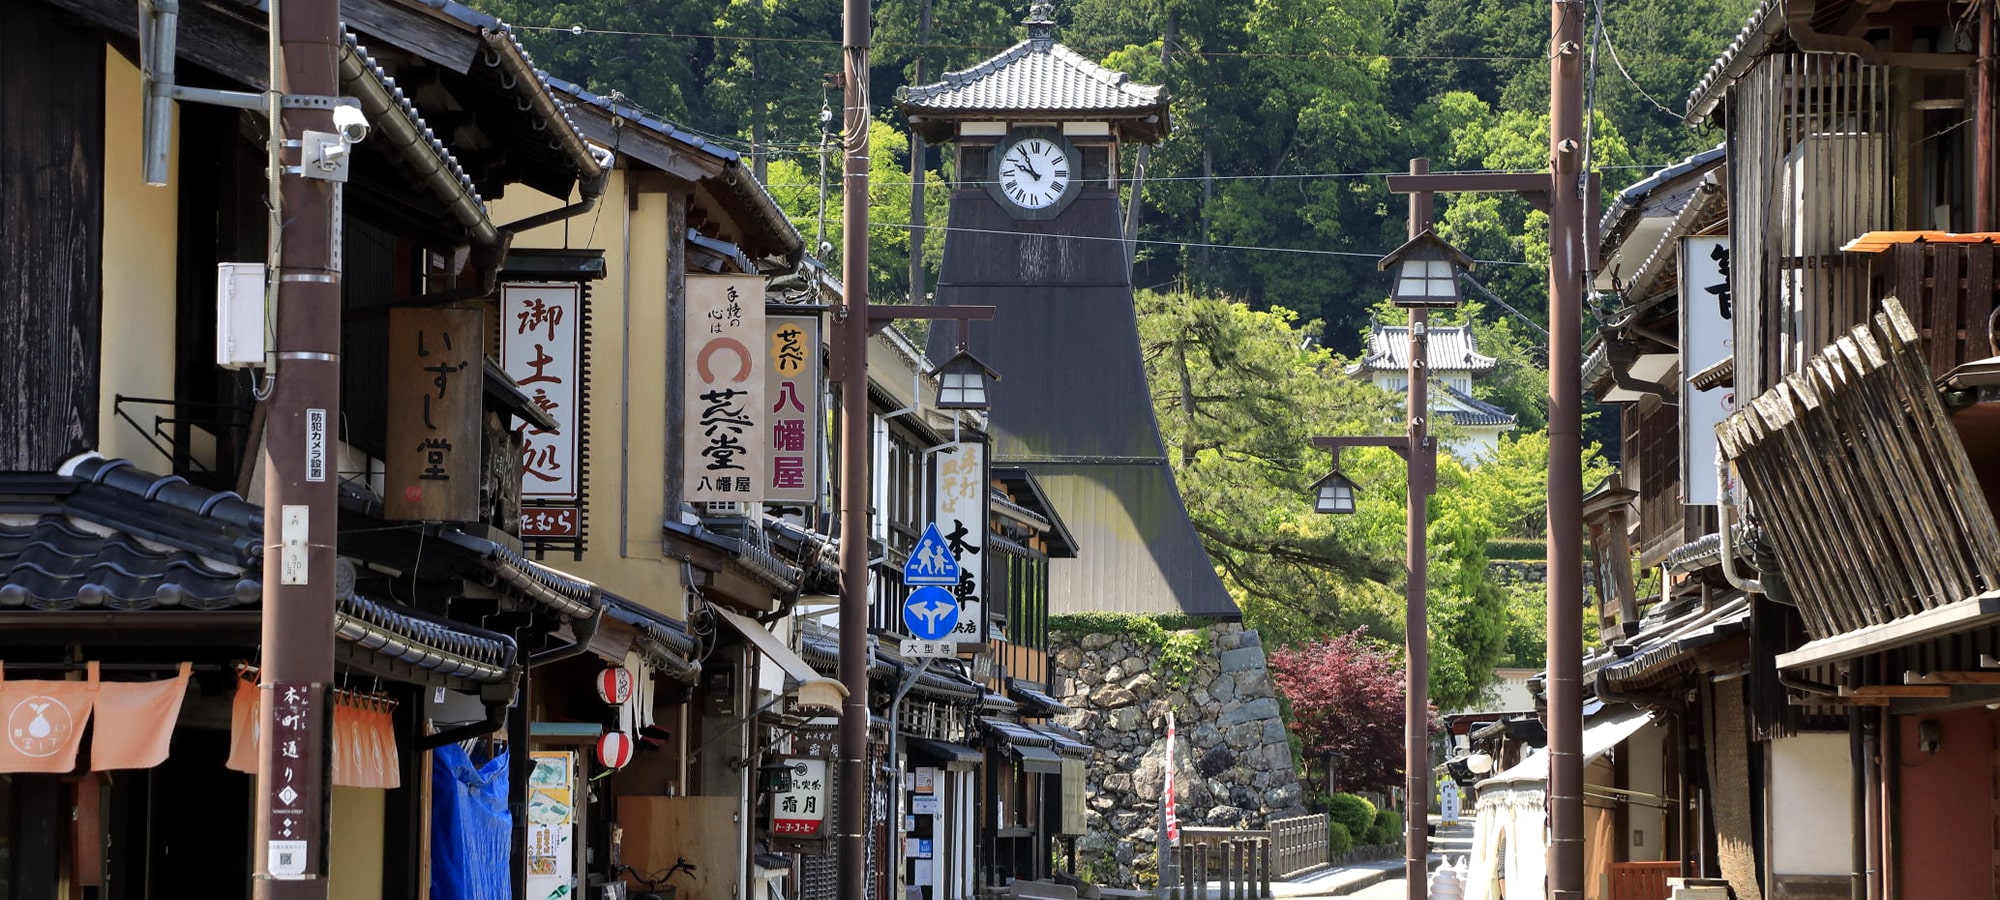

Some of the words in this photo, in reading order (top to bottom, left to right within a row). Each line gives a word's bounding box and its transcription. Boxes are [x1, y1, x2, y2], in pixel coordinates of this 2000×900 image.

[708, 309, 723, 334] 心は
[417, 331, 468, 480] いずし堂
[517, 298, 563, 482] 御土産処
[311, 412, 323, 478] 防犯カメラ設置
[772, 381, 805, 489] 八幡屋
[697, 476, 750, 492] 八幡屋
[907, 643, 951, 655] 大型等
[281, 686, 300, 783] 本町通り
[782, 795, 817, 814] 霜月
[775, 822, 815, 833] トーヨーコーヒー
